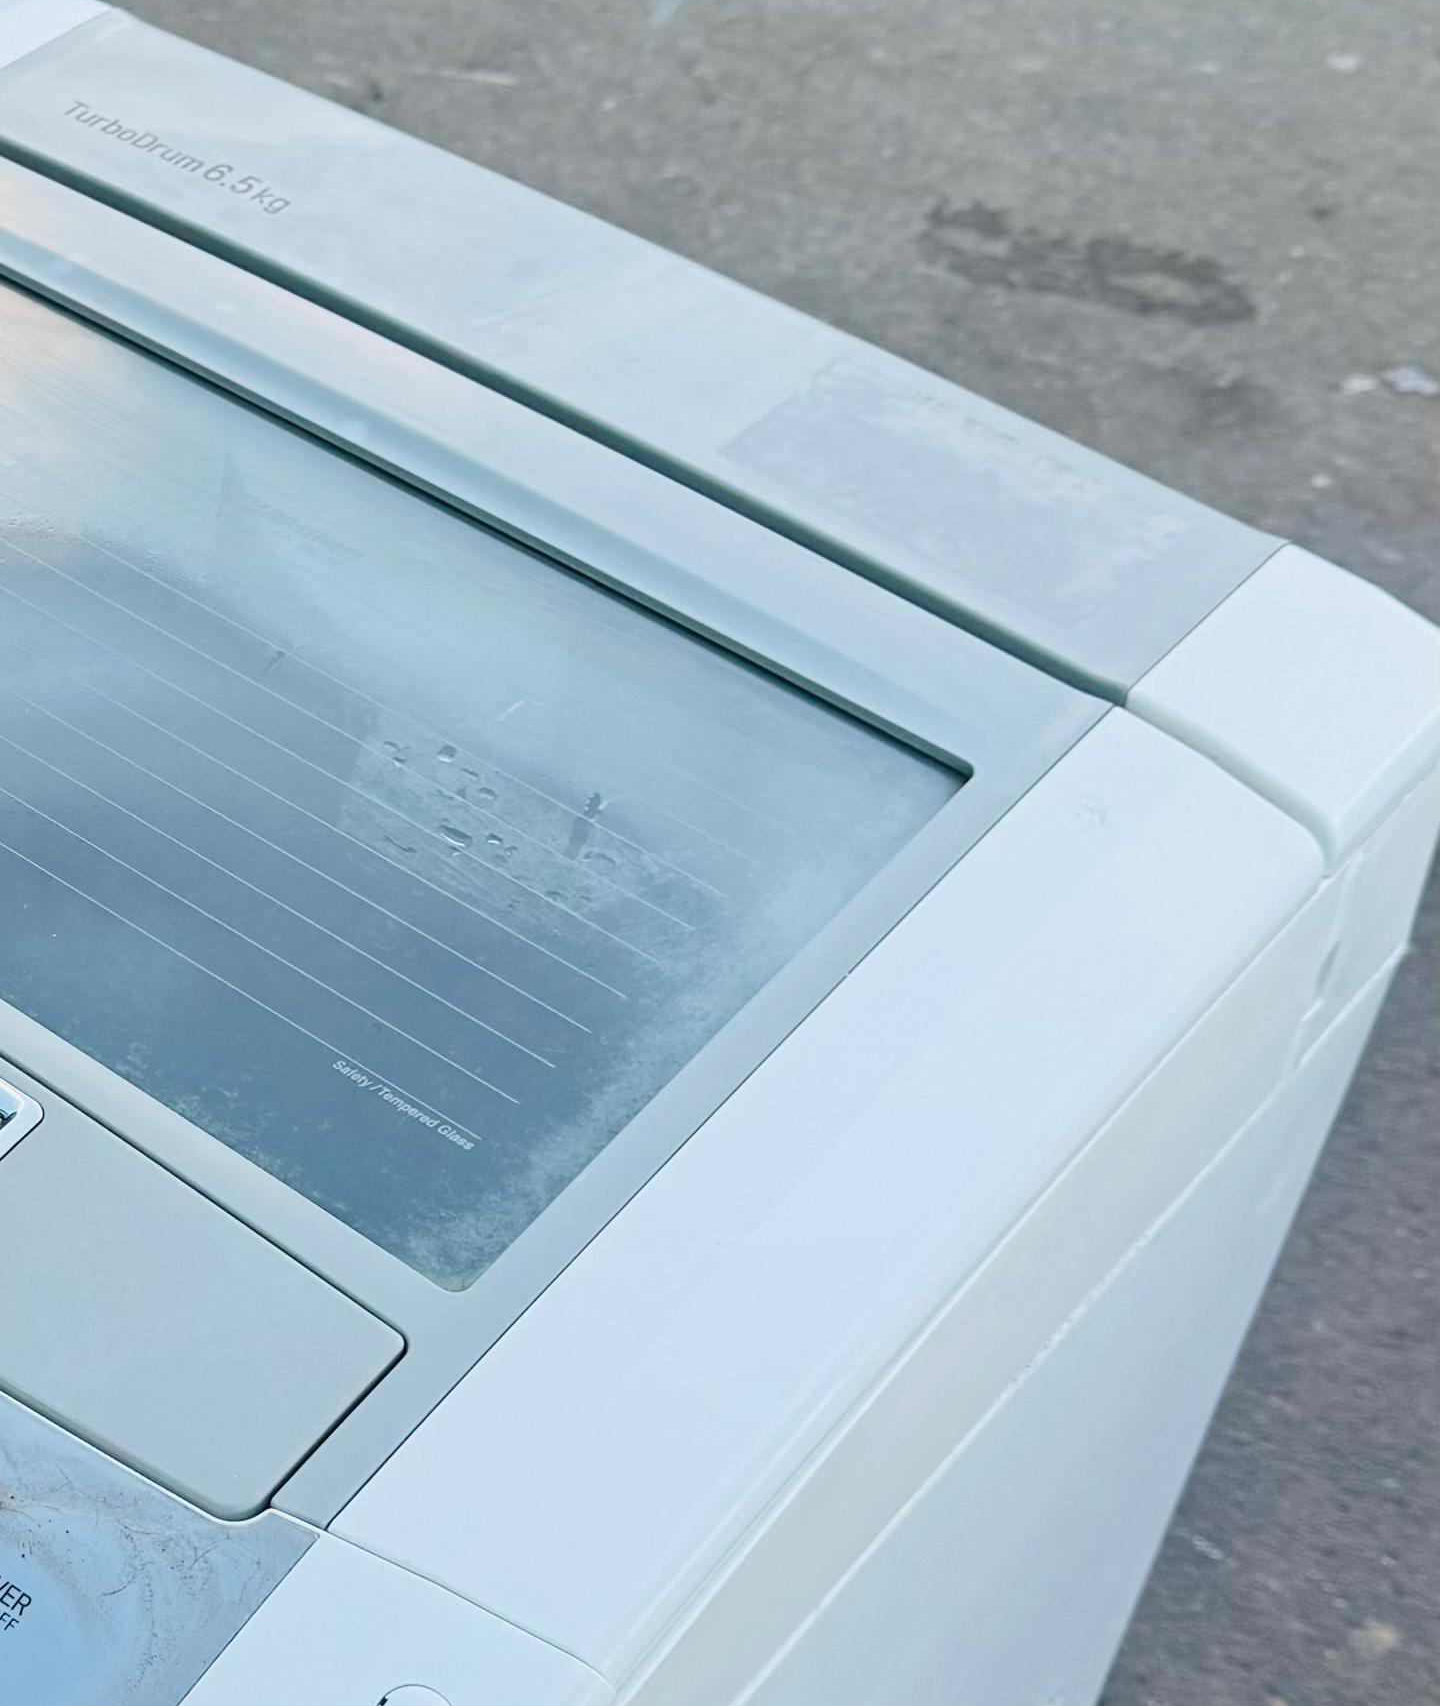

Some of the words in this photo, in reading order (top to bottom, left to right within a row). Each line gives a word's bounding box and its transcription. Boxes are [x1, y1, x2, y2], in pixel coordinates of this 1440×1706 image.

[64, 100, 205, 173] TurboDrum
[332, 1060, 372, 1088] Safety
[378, 1085, 440, 1129] Tempered
[436, 1124, 475, 1151] Glass
